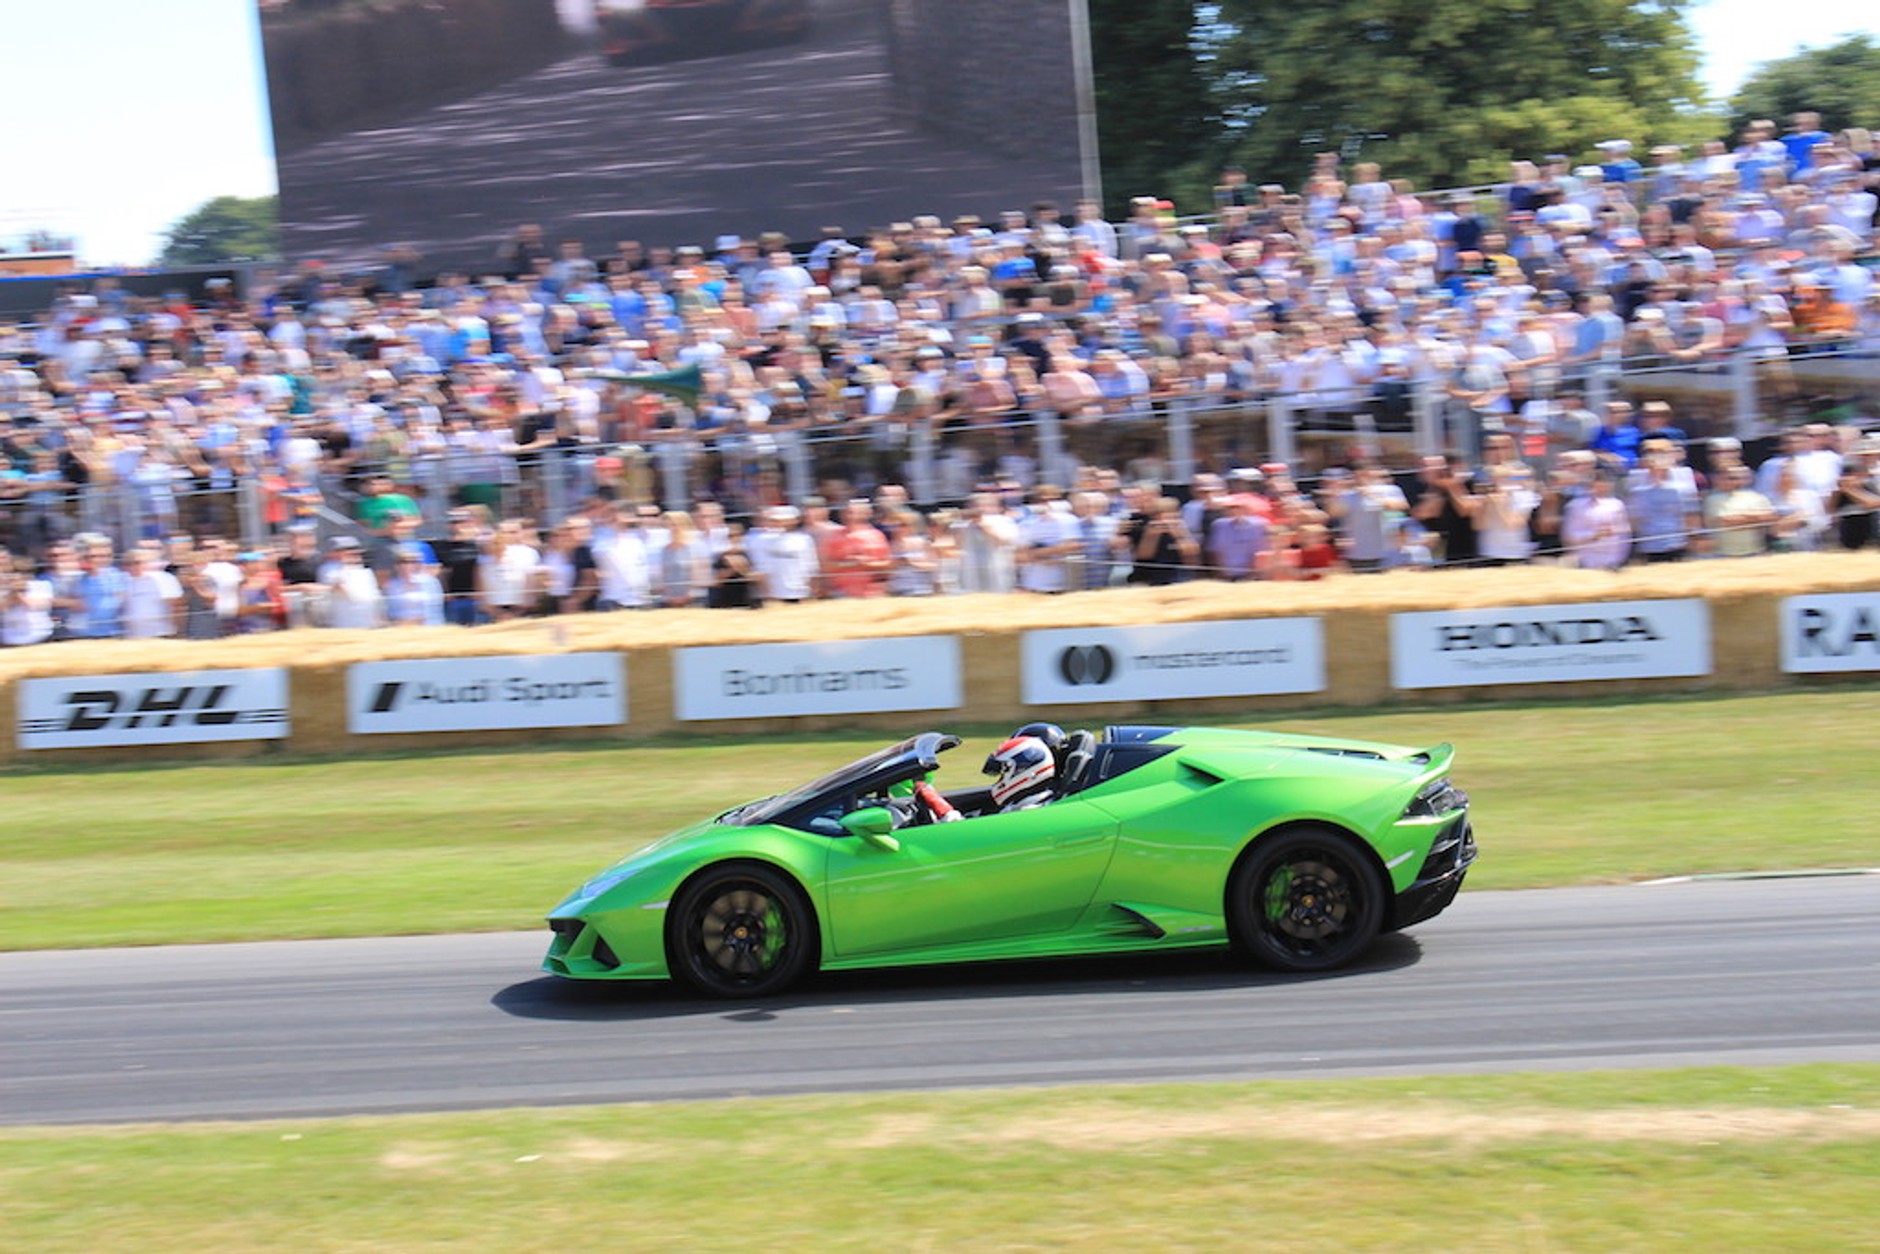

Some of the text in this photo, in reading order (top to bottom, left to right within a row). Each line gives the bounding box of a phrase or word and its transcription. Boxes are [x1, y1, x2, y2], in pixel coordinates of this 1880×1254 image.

[1437, 617, 1664, 651] HONDA
[411, 677, 615, 707] Audi Sport
[721, 667, 911, 697] Bonhams
[62, 685, 240, 731] DHL
